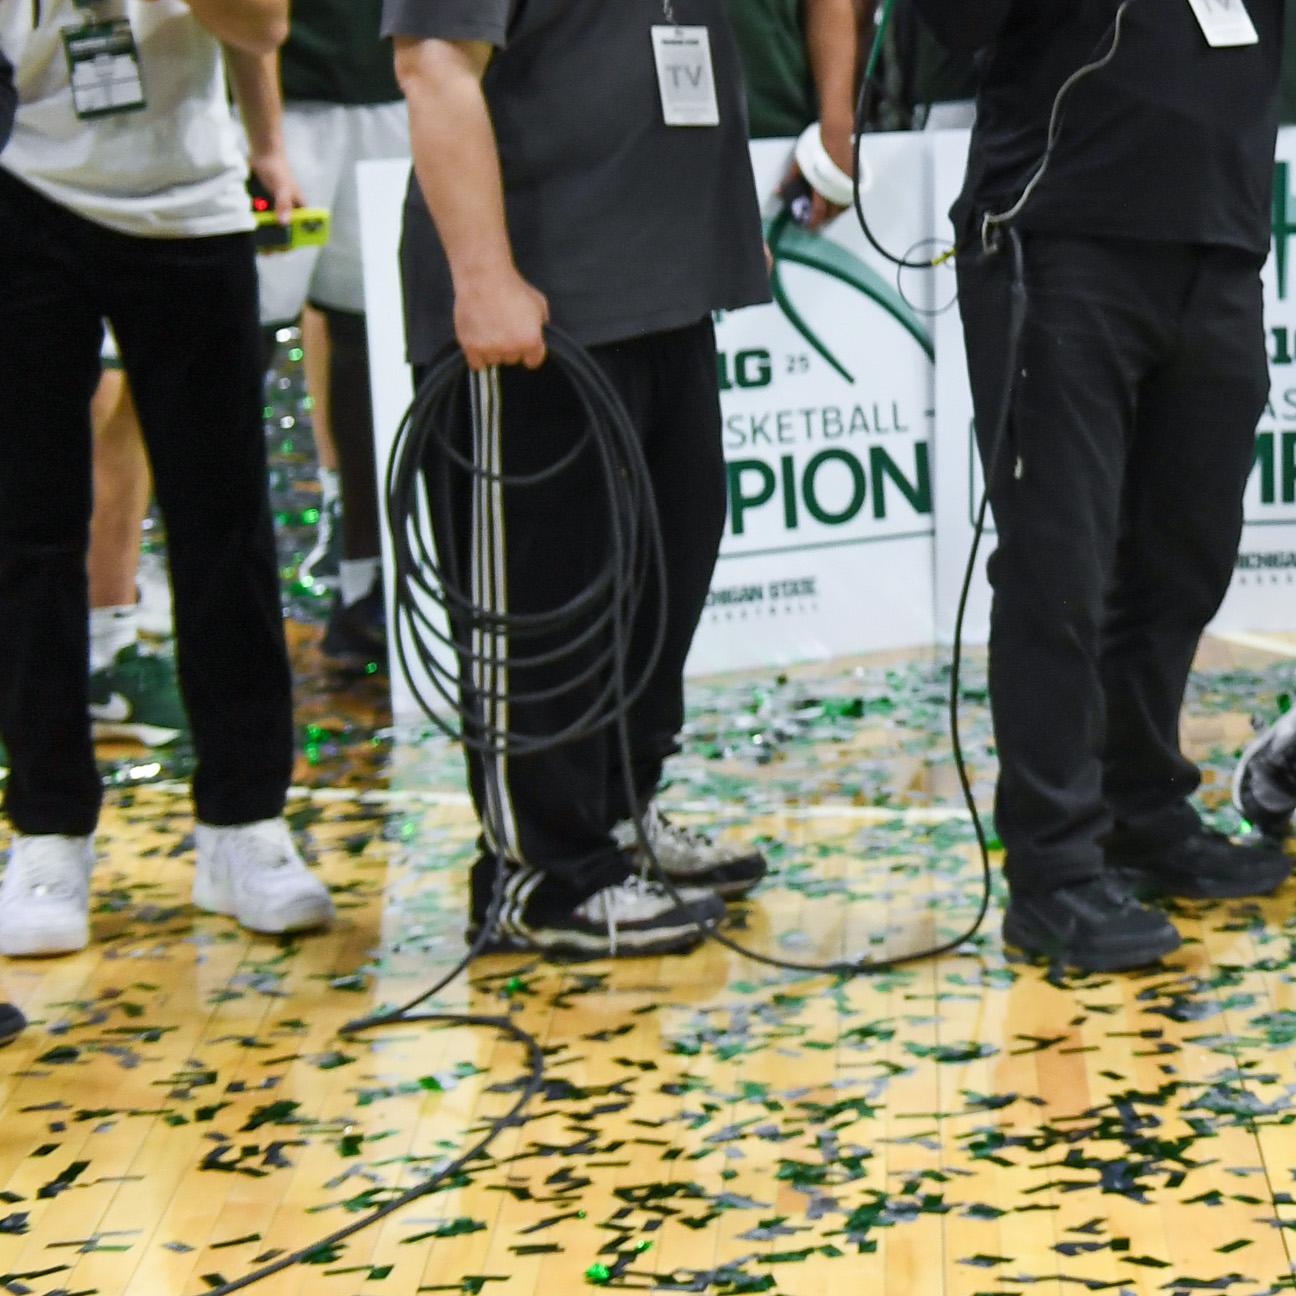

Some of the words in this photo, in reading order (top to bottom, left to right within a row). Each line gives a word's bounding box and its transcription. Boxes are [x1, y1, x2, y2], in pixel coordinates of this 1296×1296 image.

[664, 65, 703, 89] TV
[725, 400, 909, 450] SKETBALL
[727, 440, 933, 535] PION
[769, 576, 816, 600] STATE
